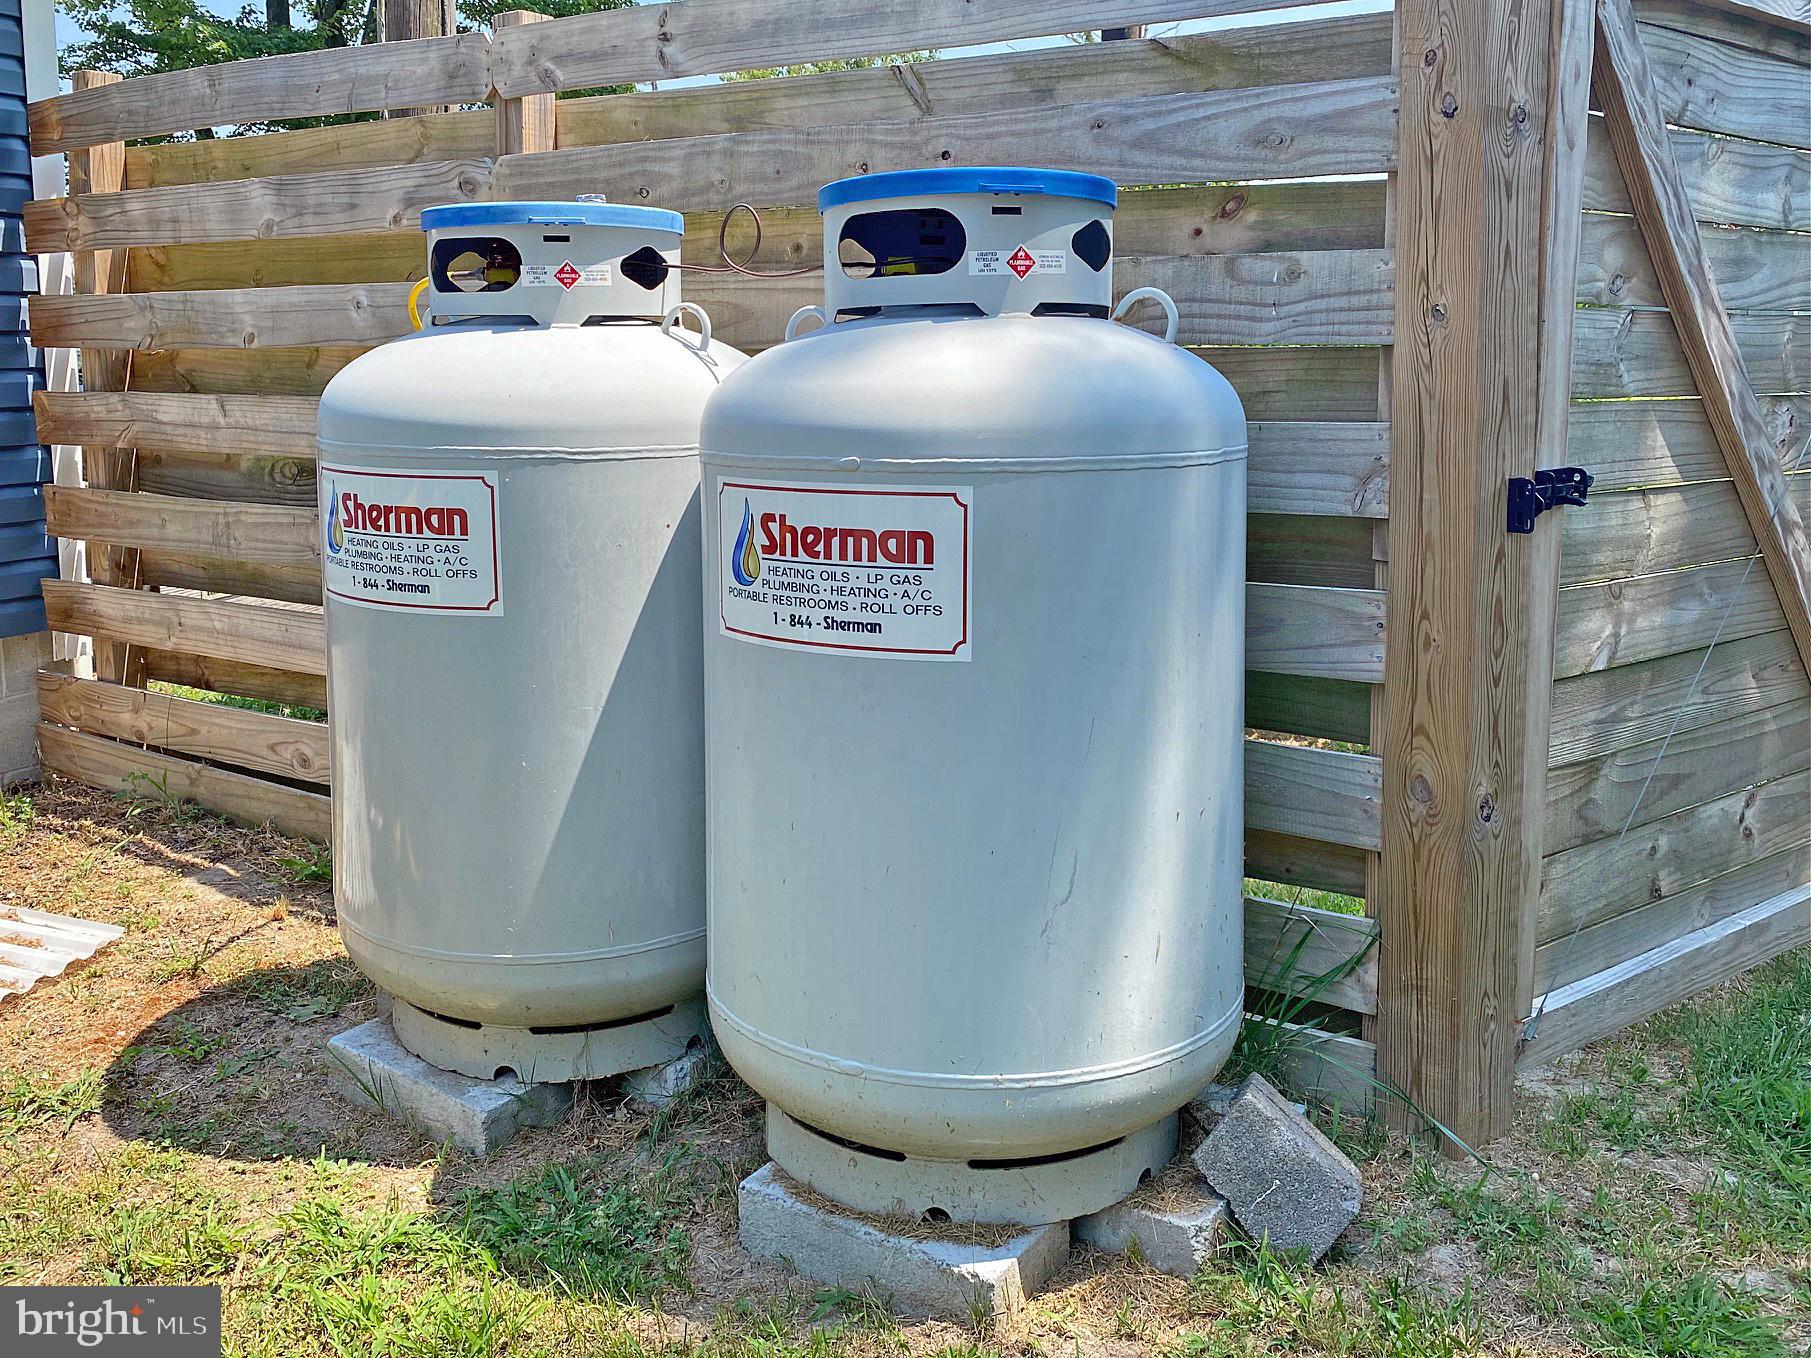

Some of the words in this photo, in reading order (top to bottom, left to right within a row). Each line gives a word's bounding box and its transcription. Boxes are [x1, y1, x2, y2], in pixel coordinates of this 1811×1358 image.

[341, 492, 469, 536] Sherman
[347, 537, 379, 549] HEATING
[382, 541, 404, 551] OILS
[417, 544, 430, 553] LP
[434, 544, 460, 554] GAS
[760, 512, 934, 565] Sherman
[344, 548, 383, 562] PLUMBING
[390, 554, 434, 565] HEATING
[443, 556, 469, 566] A/C
[351, 562, 404, 576] RESTROOMS
[412, 567, 441, 578] ROLL
[445, 569, 478, 579] OFFS
[768, 565, 815, 580] HEATING
[820, 570, 850, 583] OILS
[867, 574, 884, 584] LP
[890, 574, 923, 586] GAS
[761, 579, 820, 595] PLUMBING
[830, 585, 888, 599] HEATING
[901, 589, 932, 601] A/C
[728, 586, 768, 604] PORTABLE
[772, 595, 849, 612] RESTROOMS
[861, 603, 897, 615] ROLL
[903, 604, 943, 616] OFFS
